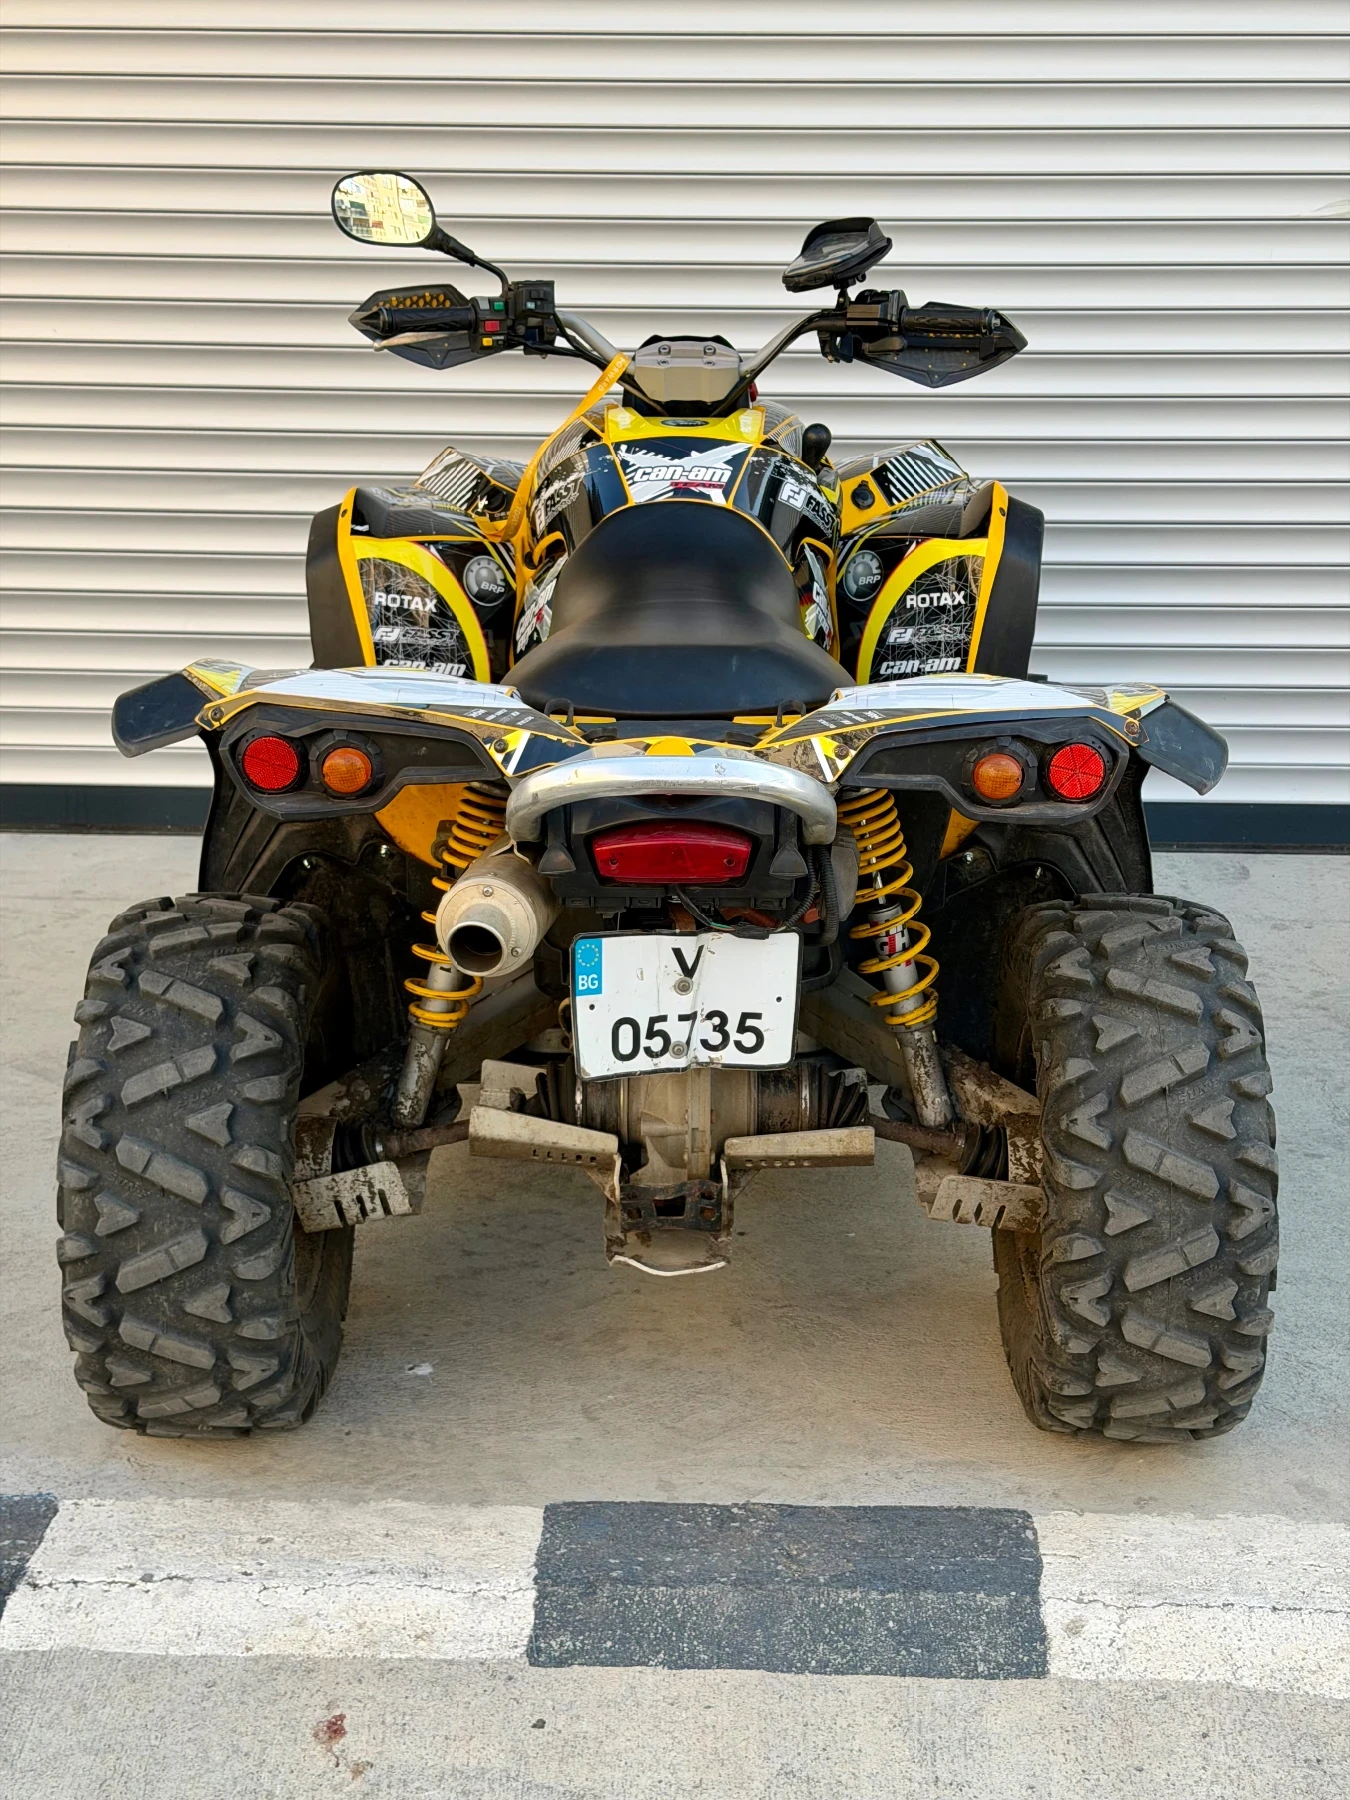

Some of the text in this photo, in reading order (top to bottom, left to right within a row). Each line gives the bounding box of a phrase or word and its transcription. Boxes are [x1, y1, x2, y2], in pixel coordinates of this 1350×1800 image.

[633, 464, 733, 483] can-am
[480, 582, 506, 595] BRP
[859, 575, 882, 587] BRP
[374, 592, 438, 613] ROTAX
[906, 591, 966, 609] ROTAX
[879, 656, 962, 675] can-am
[671, 944, 705, 980] V
[578, 974, 599, 991] BG
[611, 1009, 765, 1062] 05735
